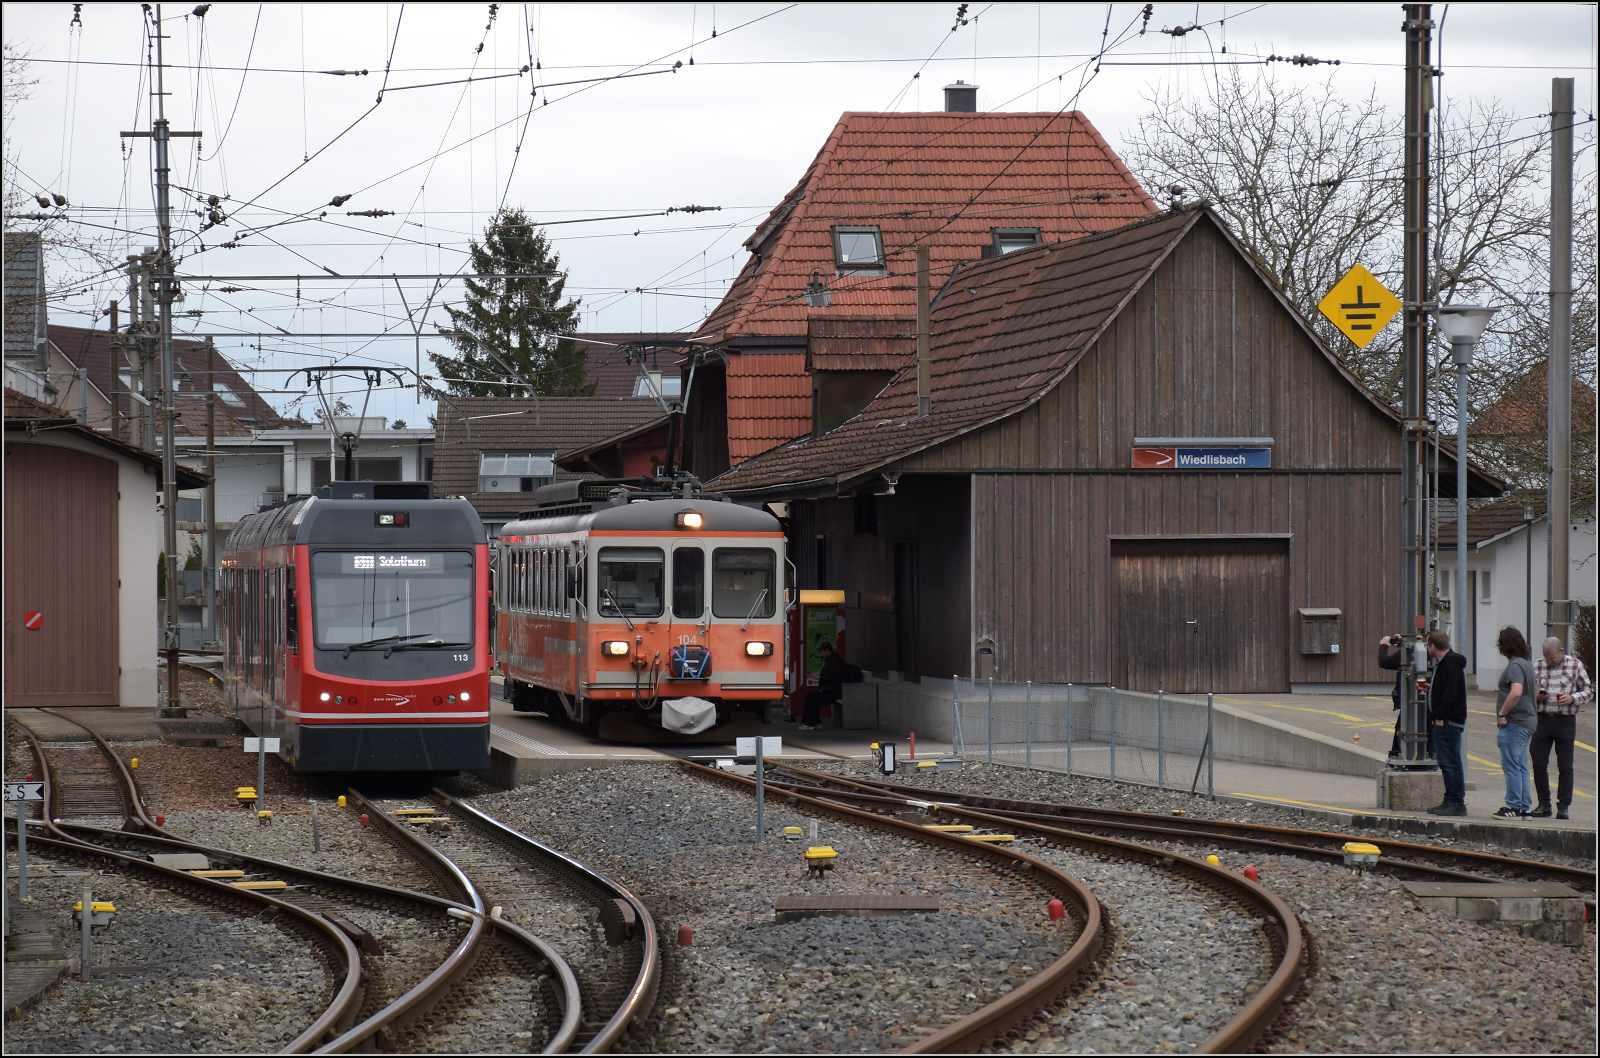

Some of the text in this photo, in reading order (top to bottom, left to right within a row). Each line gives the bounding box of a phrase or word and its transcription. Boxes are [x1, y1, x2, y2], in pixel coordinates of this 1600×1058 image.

[1179, 454, 1246, 465] Wiedlisbach
[379, 555, 427, 567] Solothurn
[677, 634, 697, 646] 104
[453, 654, 469, 662] 113
[16, 785, 26, 800] S
